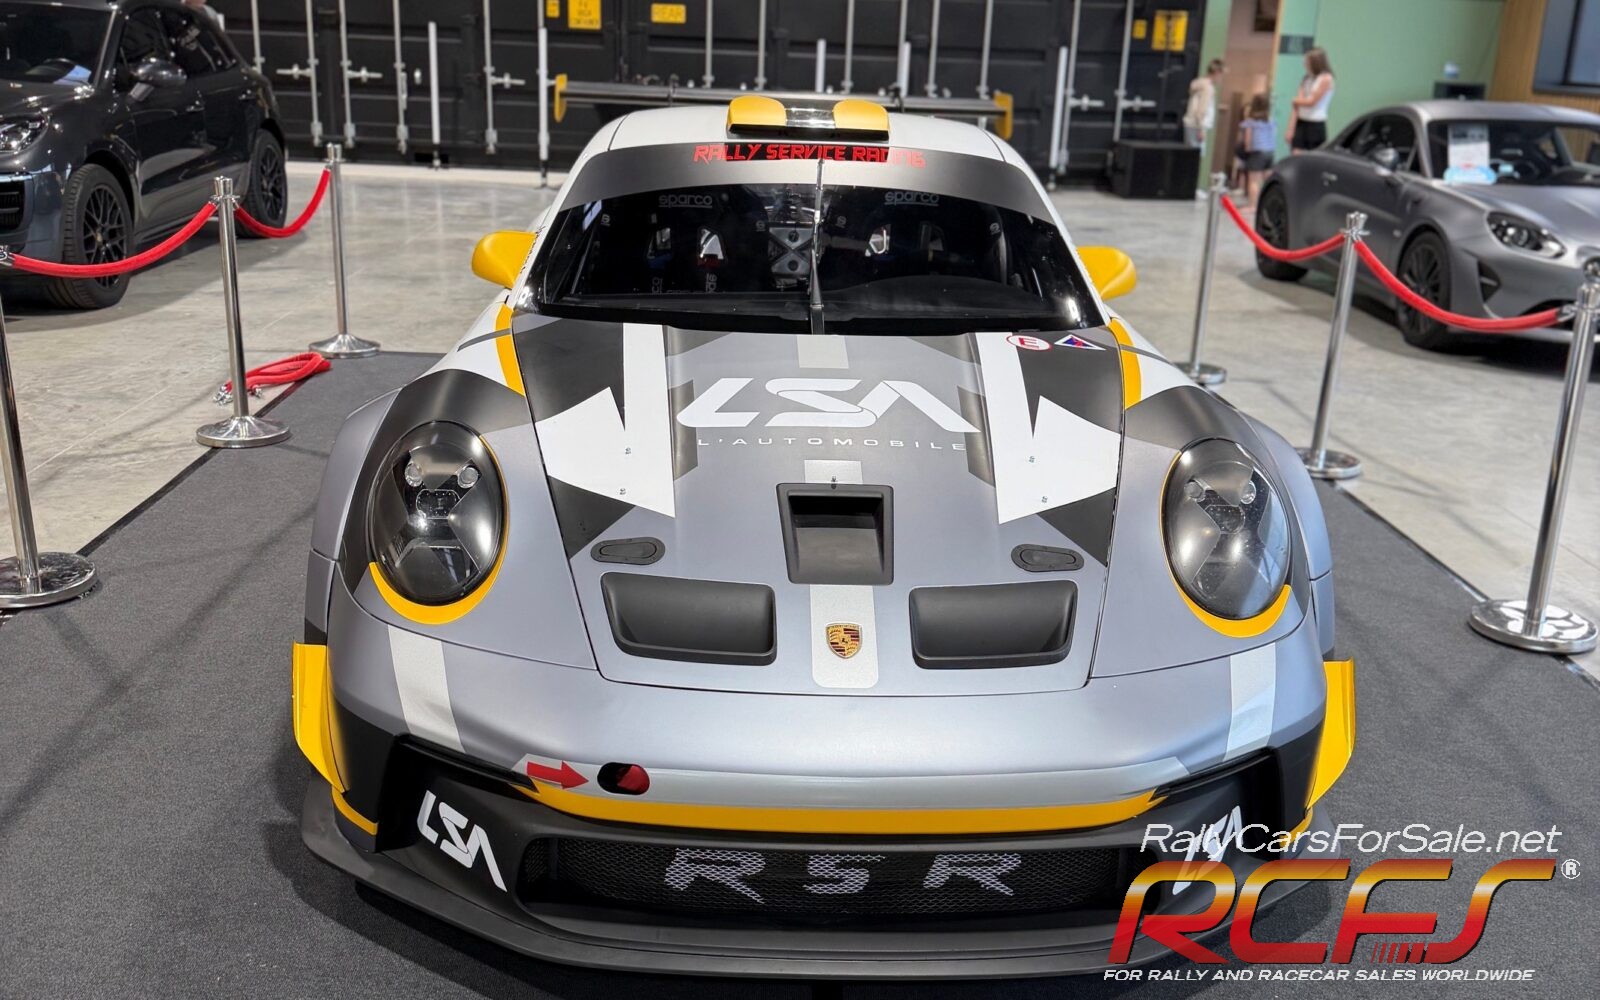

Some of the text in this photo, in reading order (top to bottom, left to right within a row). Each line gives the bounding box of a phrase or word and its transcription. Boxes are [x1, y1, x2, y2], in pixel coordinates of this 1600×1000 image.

[693, 143, 761, 165] RALLY
[765, 143, 846, 161] SERVICE
[658, 194, 713, 208] sparco
[884, 190, 940, 206] sparco
[676, 377, 982, 433] LSA
[697, 437, 968, 451] L'AUTOMOBILE
[417, 790, 508, 893] LSA
